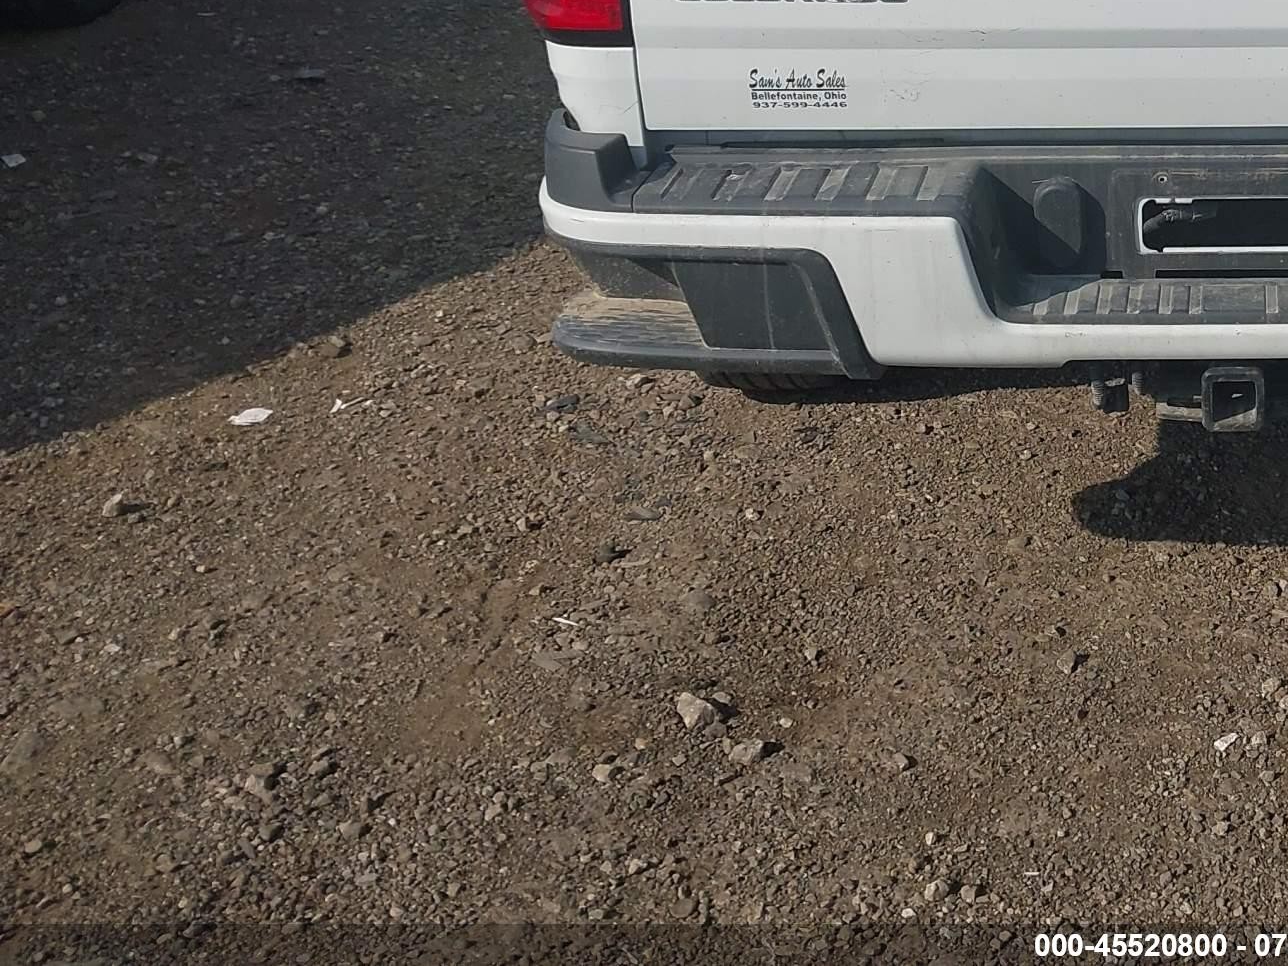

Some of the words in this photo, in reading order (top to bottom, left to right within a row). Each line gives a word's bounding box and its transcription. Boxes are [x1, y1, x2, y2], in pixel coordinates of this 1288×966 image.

[749, 68, 782, 89] Sam's
[785, 68, 813, 89] Auto
[816, 68, 848, 89] Sales
[751, 92, 822, 101] Bellefontaine,
[824, 92, 847, 100] Ohio
[752, 101, 848, 109] 937-599-4446
